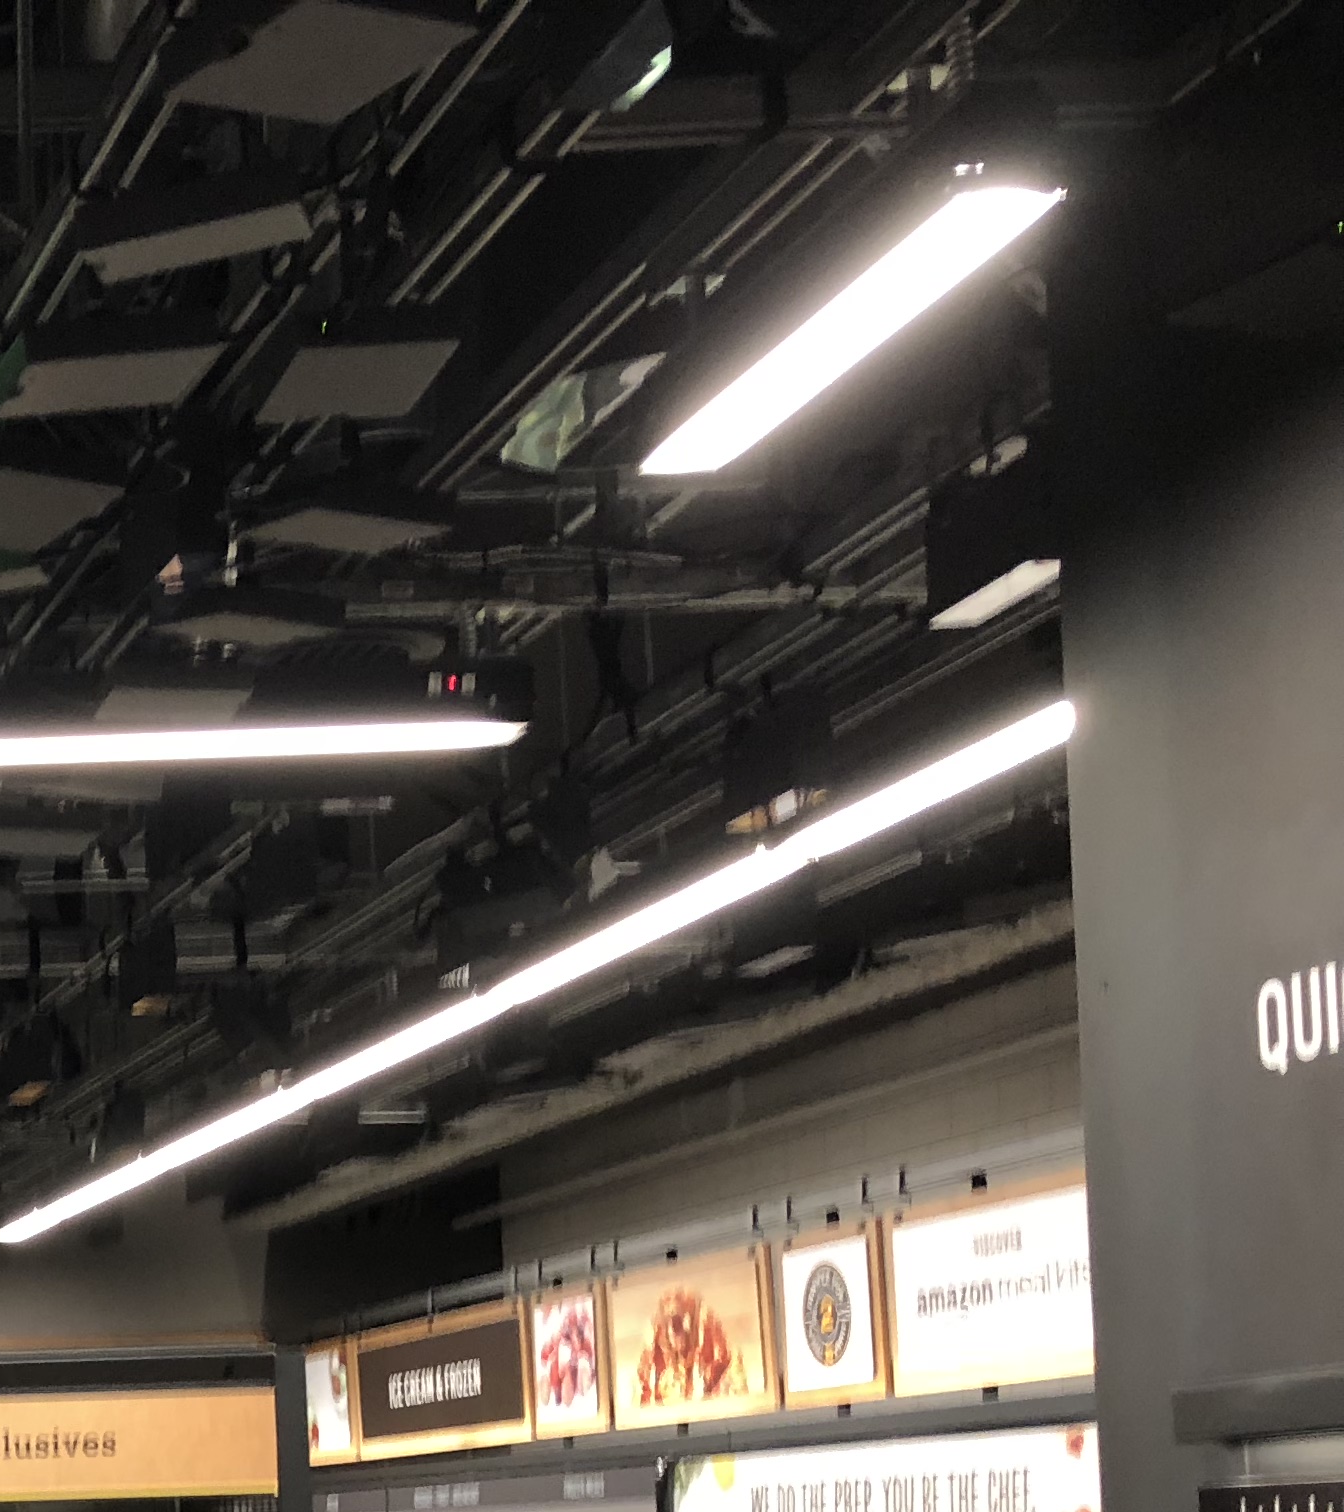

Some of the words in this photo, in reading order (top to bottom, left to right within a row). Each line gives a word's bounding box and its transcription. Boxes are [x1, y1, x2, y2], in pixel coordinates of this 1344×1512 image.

[1257, 962, 1344, 1076] QUI
[917, 1278, 993, 1318] amazon
[388, 1372, 404, 1409] ICE
[404, 1366, 435, 1407] CREAM
[436, 1364, 444, 1401] &
[444, 1358, 481, 1400] FROZEN
